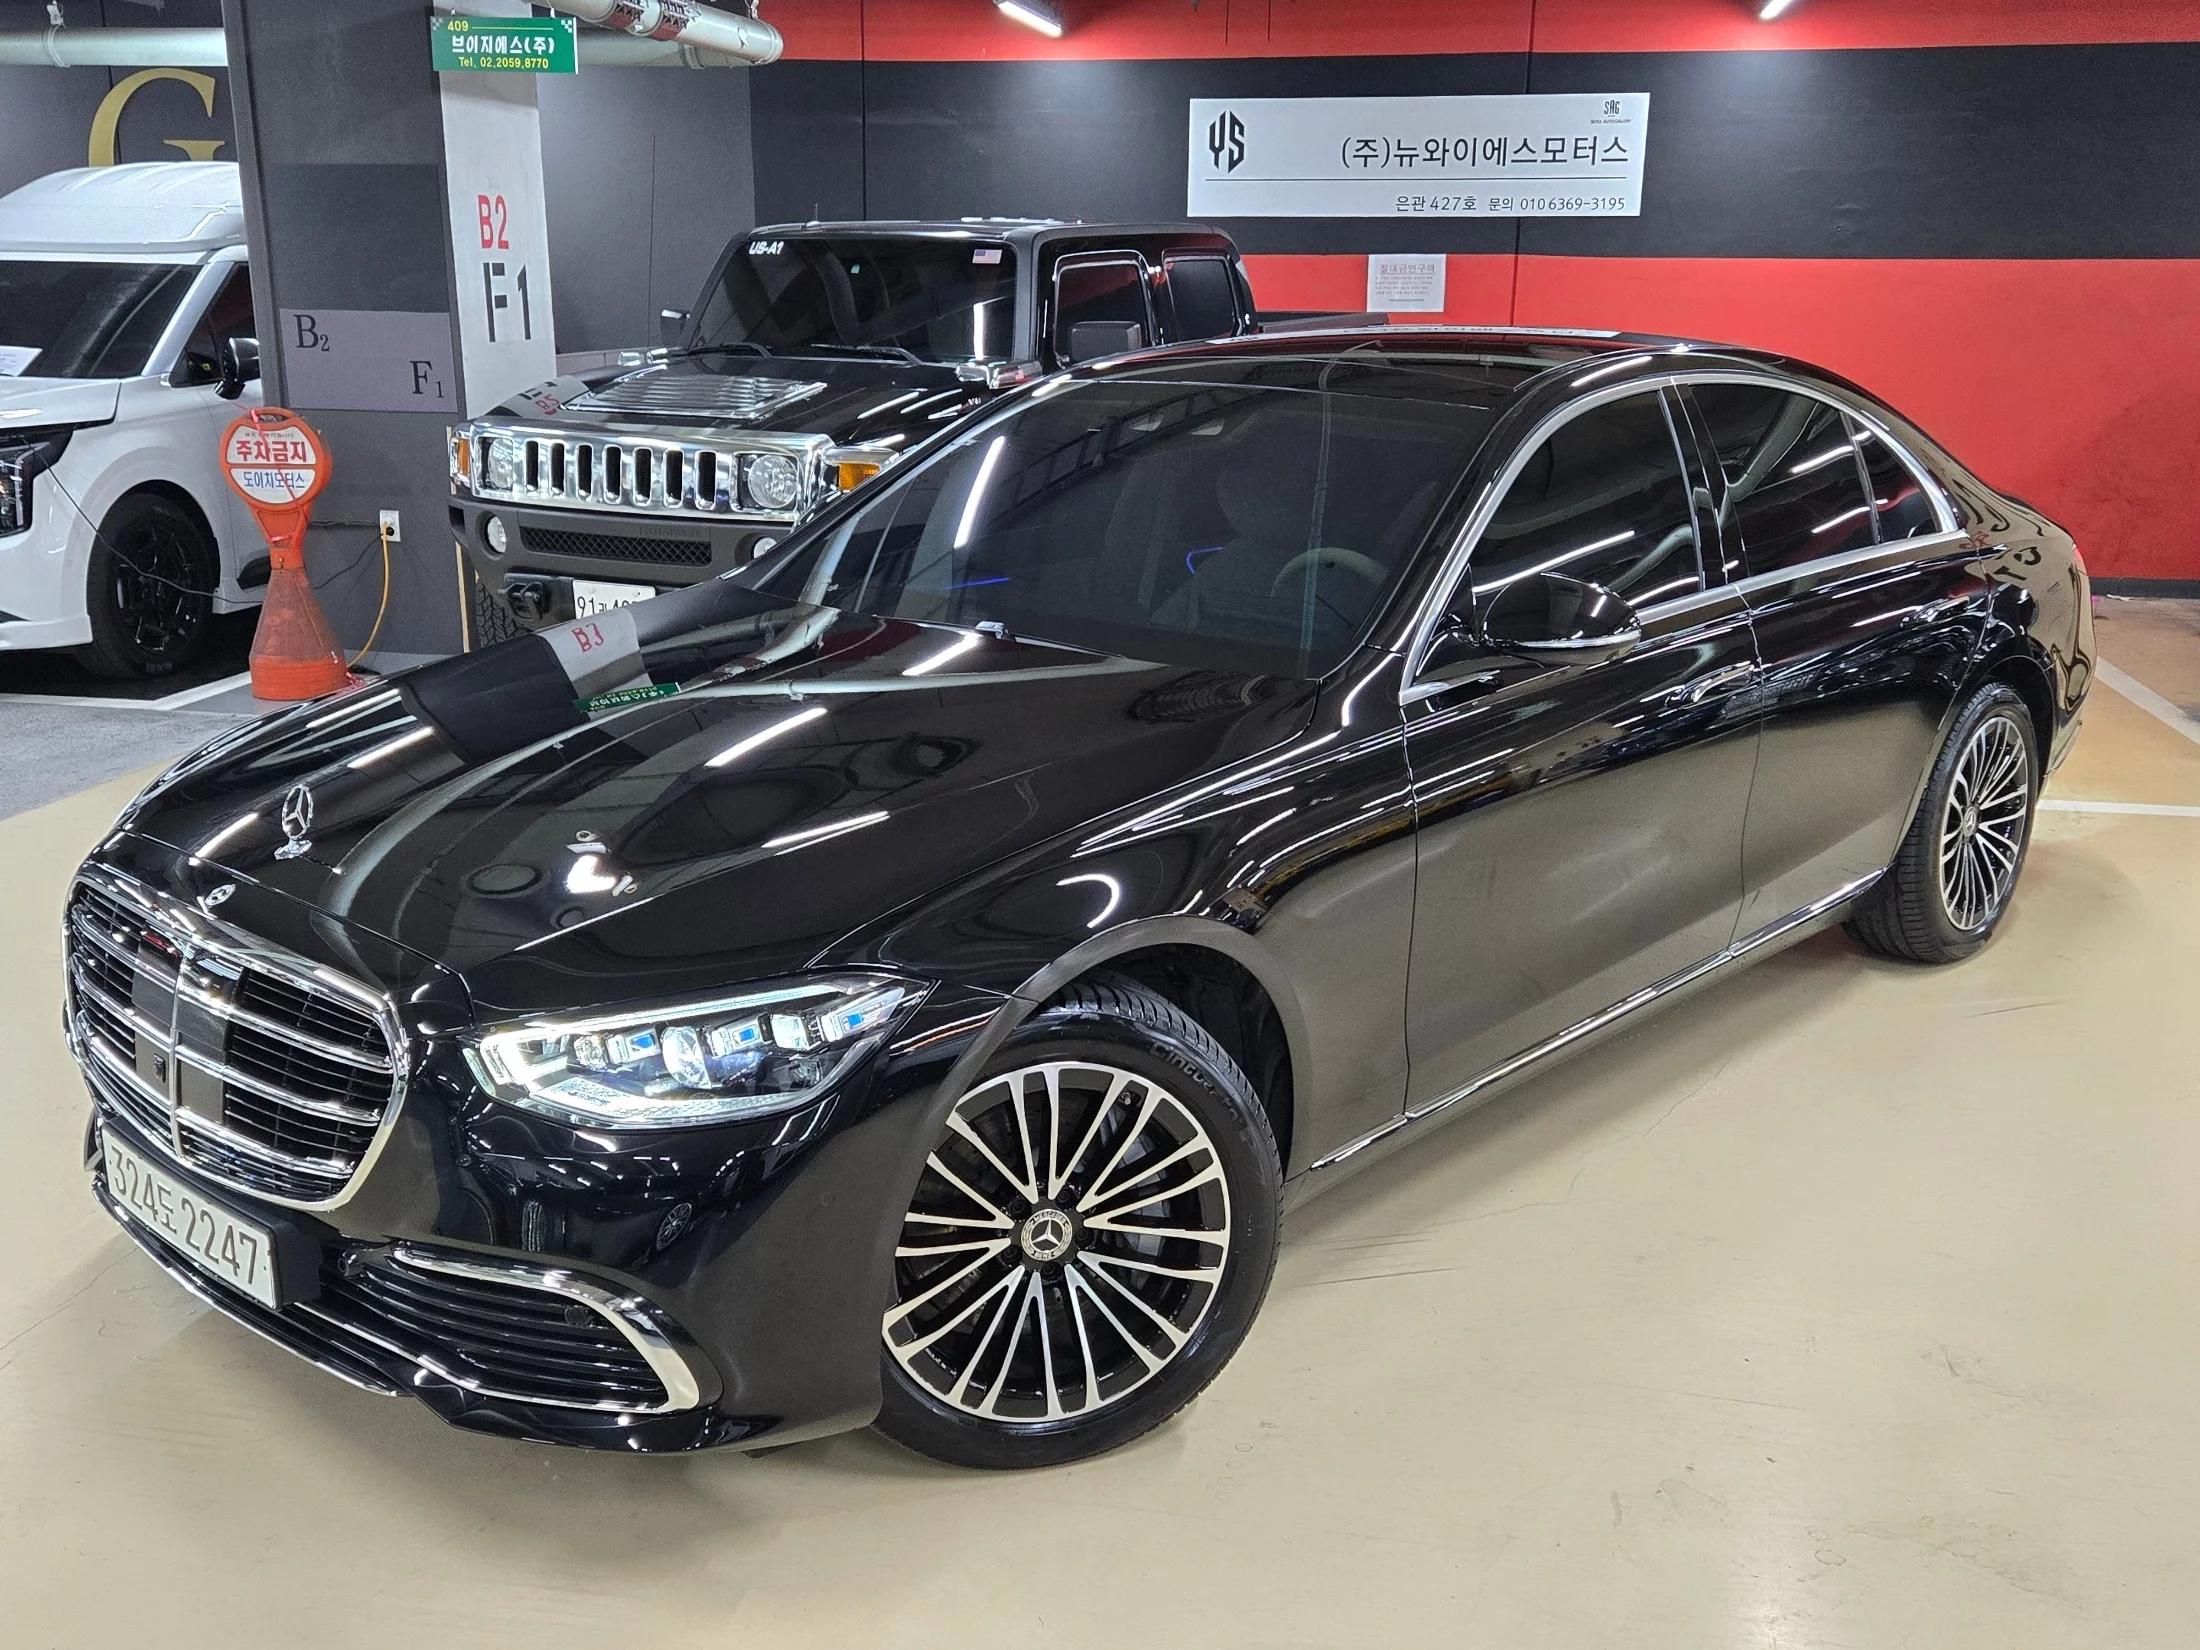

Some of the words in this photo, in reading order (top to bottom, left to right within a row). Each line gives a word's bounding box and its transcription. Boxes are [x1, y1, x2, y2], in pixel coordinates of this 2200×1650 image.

[447, 20, 469, 32] 409
[452, 35, 555, 54] 브이지에스(주)
[458, 56, 477, 68] Tel.
[480, 56, 549, 69] 02.2059.8770
[1604, 99, 1620, 115] SAG
[1209, 110, 1245, 173] YS
[1341, 135, 1629, 168] (주)뉴와이에스모터스
[1395, 195, 1426, 212] 은관
[1429, 195, 1477, 211] 427호
[1488, 197, 1514, 212] 문의
[477, 194, 509, 250] B2
[482, 261, 531, 343] F1
[294, 313, 330, 352] B2
[409, 359, 444, 399] F1
[235, 439, 307, 463] 주차금지
[243, 471, 305, 489] 도이치모터스
[111, 1146, 177, 1235] 324도
[181, 1196, 257, 1286] 2247
